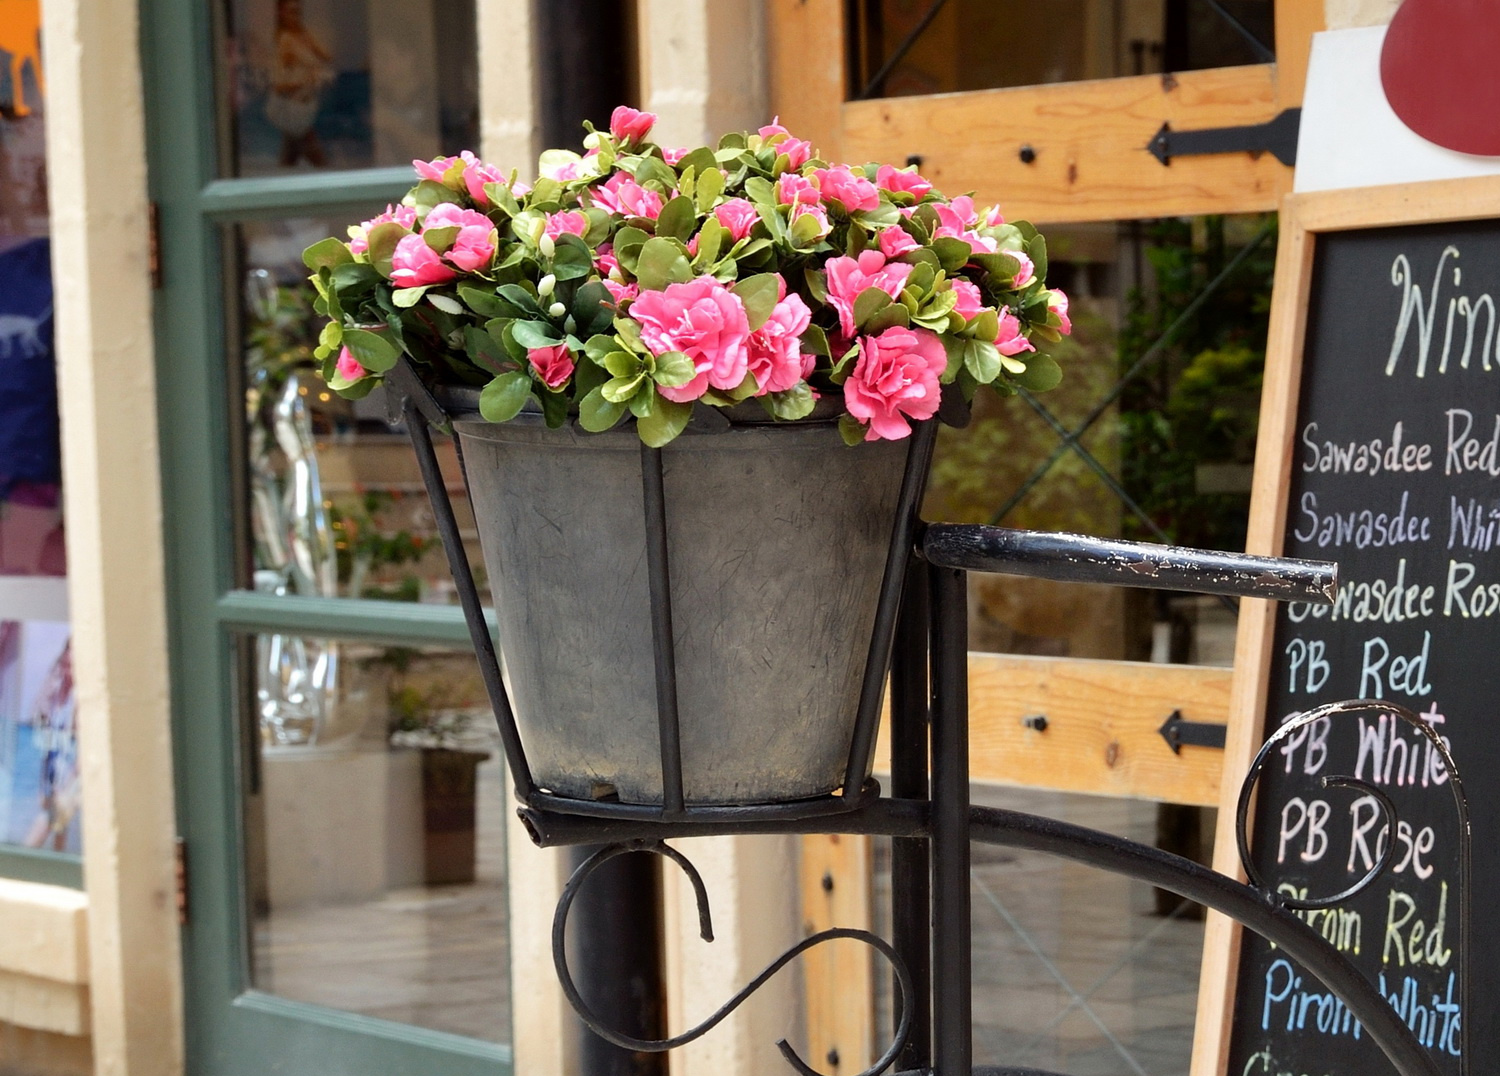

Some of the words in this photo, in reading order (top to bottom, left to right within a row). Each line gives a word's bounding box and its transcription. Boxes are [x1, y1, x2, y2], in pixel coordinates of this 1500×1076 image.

[1302, 420, 1433, 476] Sawasdee
[1294, 490, 1431, 551] Sawasdee
[1286, 638, 1331, 693] PB
[1359, 630, 1432, 700] Red
[1280, 711, 1332, 775] PB
[1355, 701, 1452, 788] White
[1277, 797, 1329, 863] PB
[1383, 880, 1452, 967] Red
